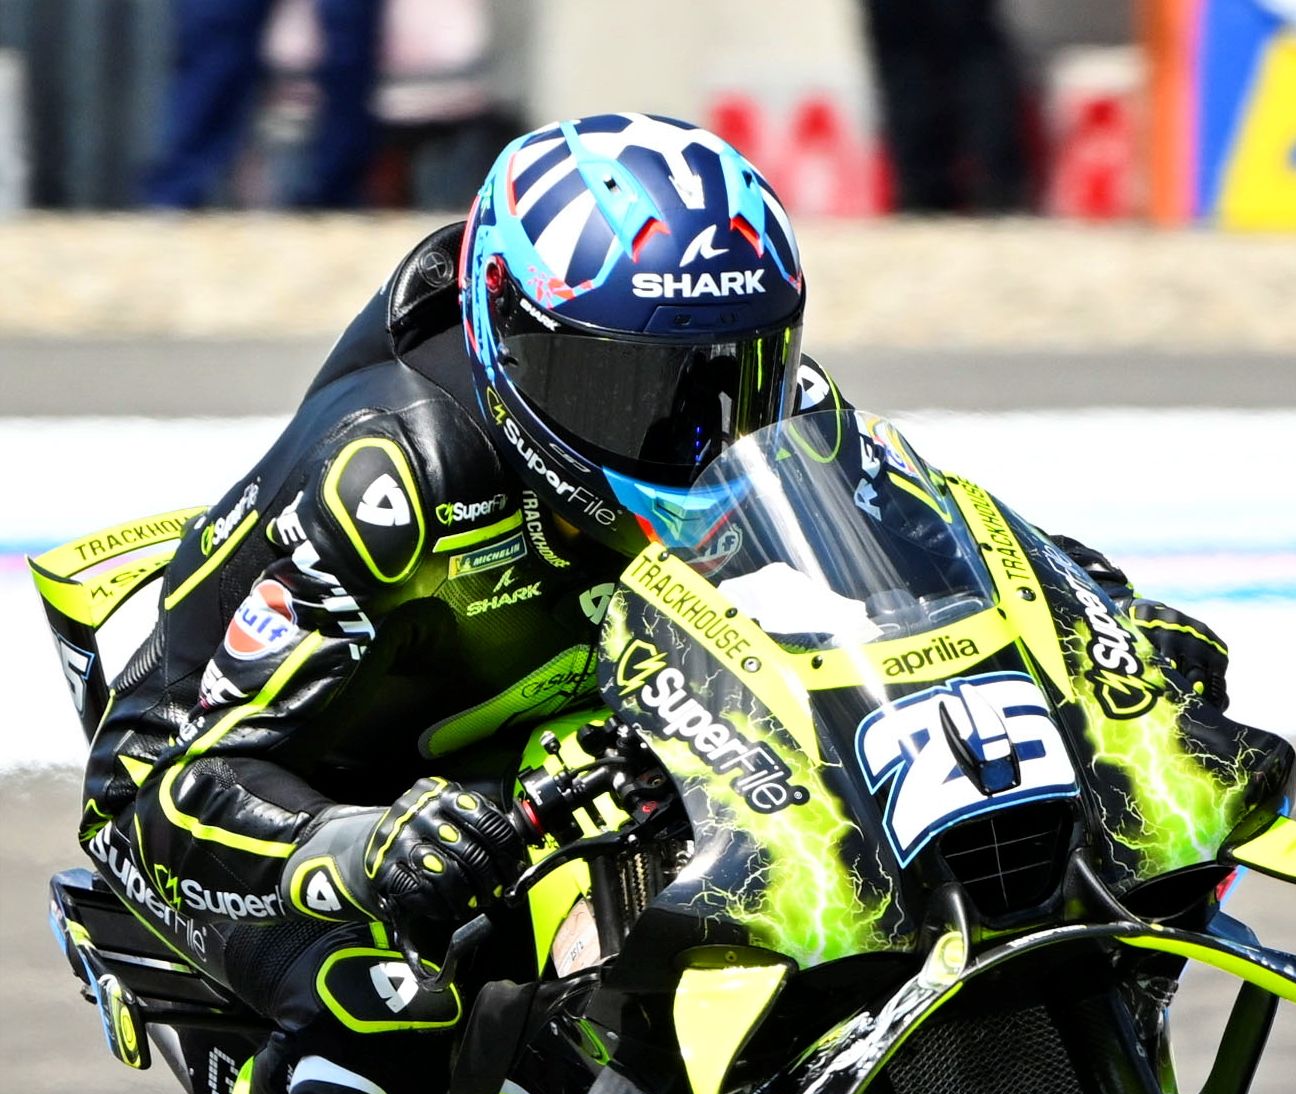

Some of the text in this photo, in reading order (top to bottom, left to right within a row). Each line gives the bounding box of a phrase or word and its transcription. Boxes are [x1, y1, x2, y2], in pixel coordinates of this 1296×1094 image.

[632, 269, 766, 298] SHARK
[519, 298, 561, 332] SHARK
[503, 418, 616, 526] SuperFile
[472, 542, 521, 567] MICHELIN
[466, 581, 543, 617] SHARK
[628, 555, 751, 662] TRACKHOUSE
[238, 602, 290, 642] ulf
[882, 635, 980, 677] aprilia
[641, 667, 788, 809] SuperFile
[854, 670, 1081, 870] 25
